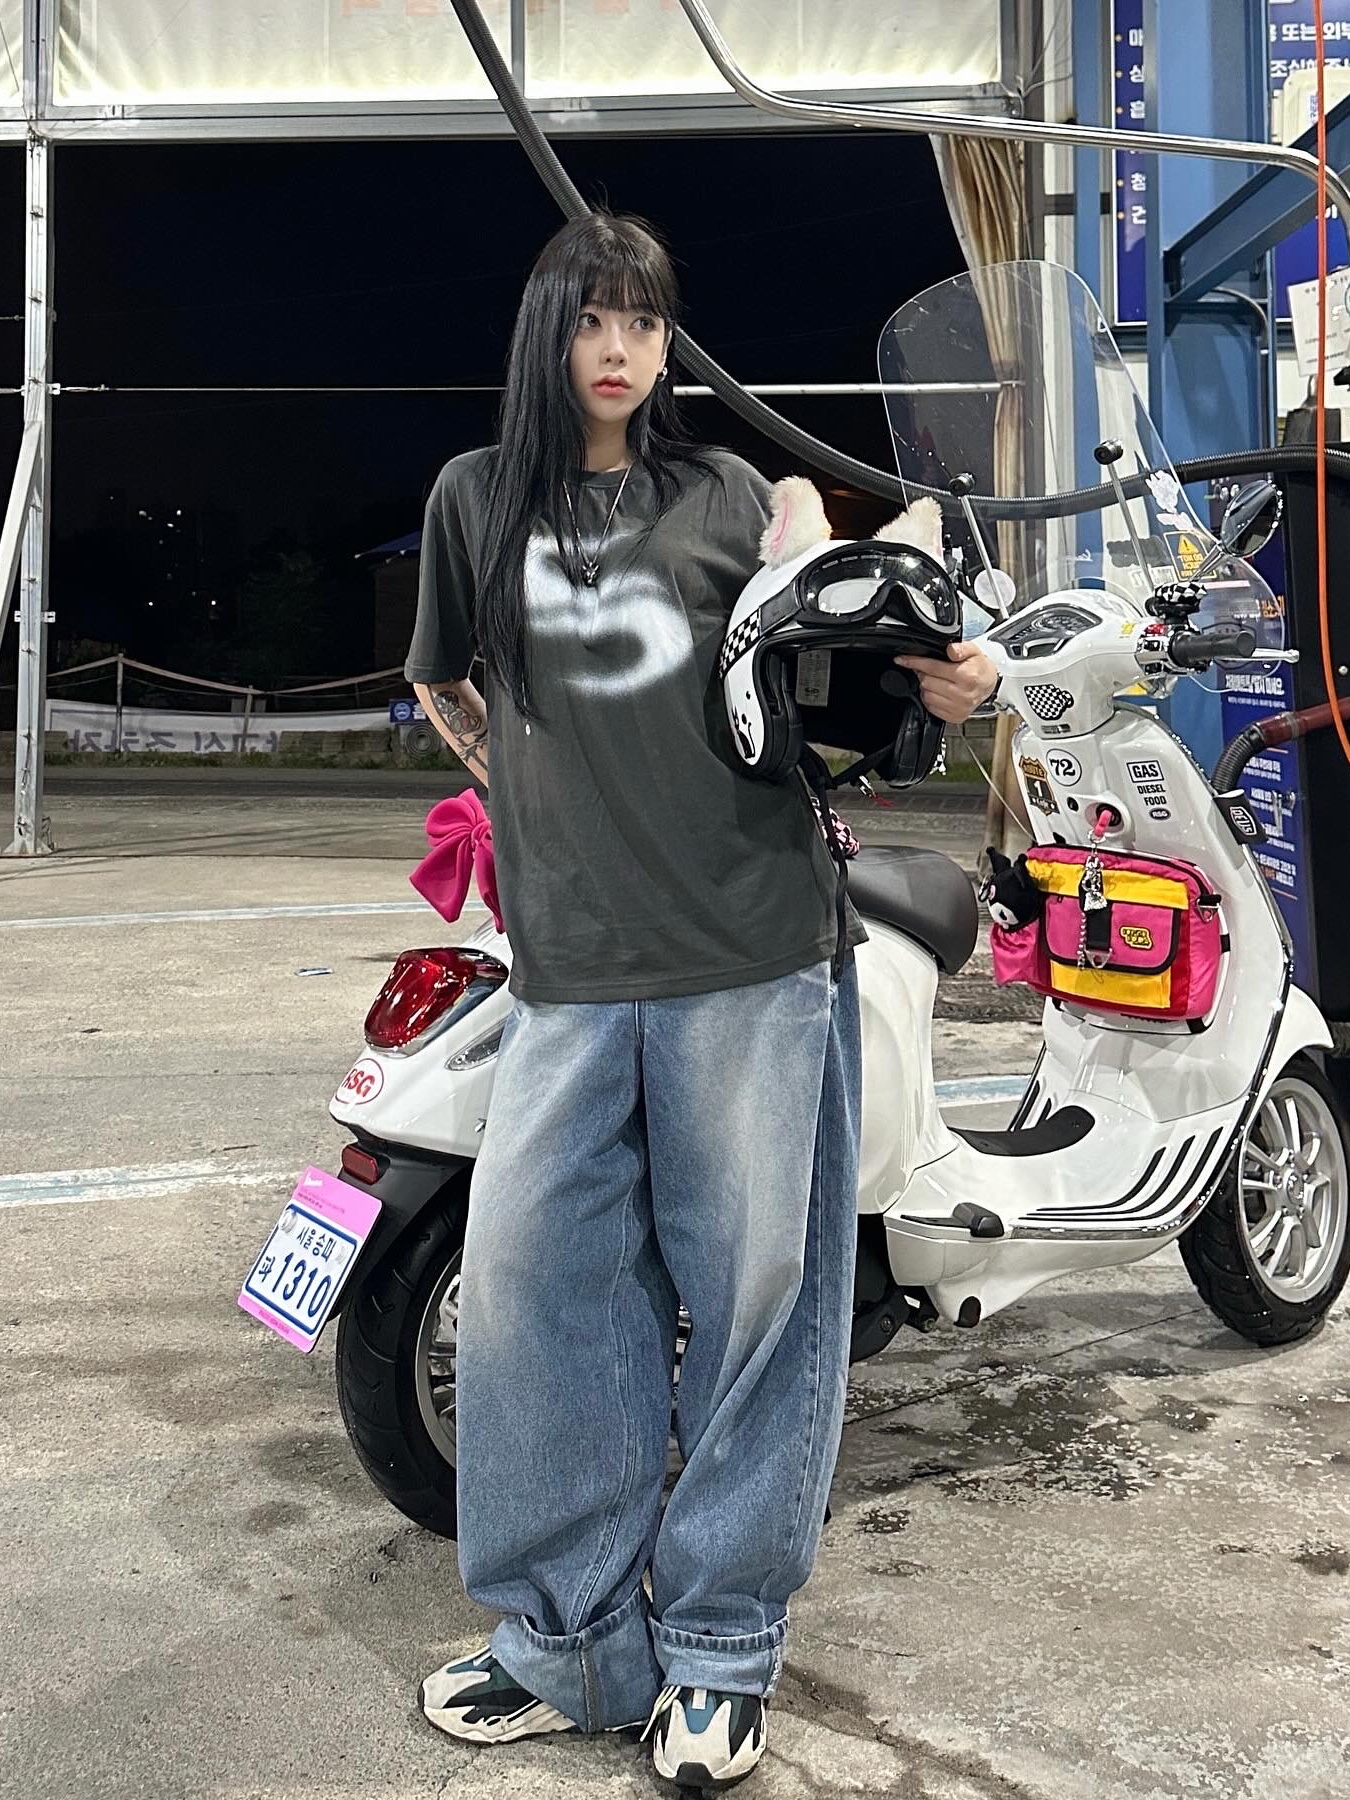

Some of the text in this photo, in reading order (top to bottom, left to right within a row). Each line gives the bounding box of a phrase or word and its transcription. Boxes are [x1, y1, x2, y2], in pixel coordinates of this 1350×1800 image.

[1049, 758, 1076, 777] 72
[1132, 763, 1159, 778] GAS
[1137, 783, 1167, 795] DIESEL
[1143, 795, 1167, 806] FOOD
[1232, 809, 1253, 833] DEUS
[272, 1251, 332, 1318] 1310
